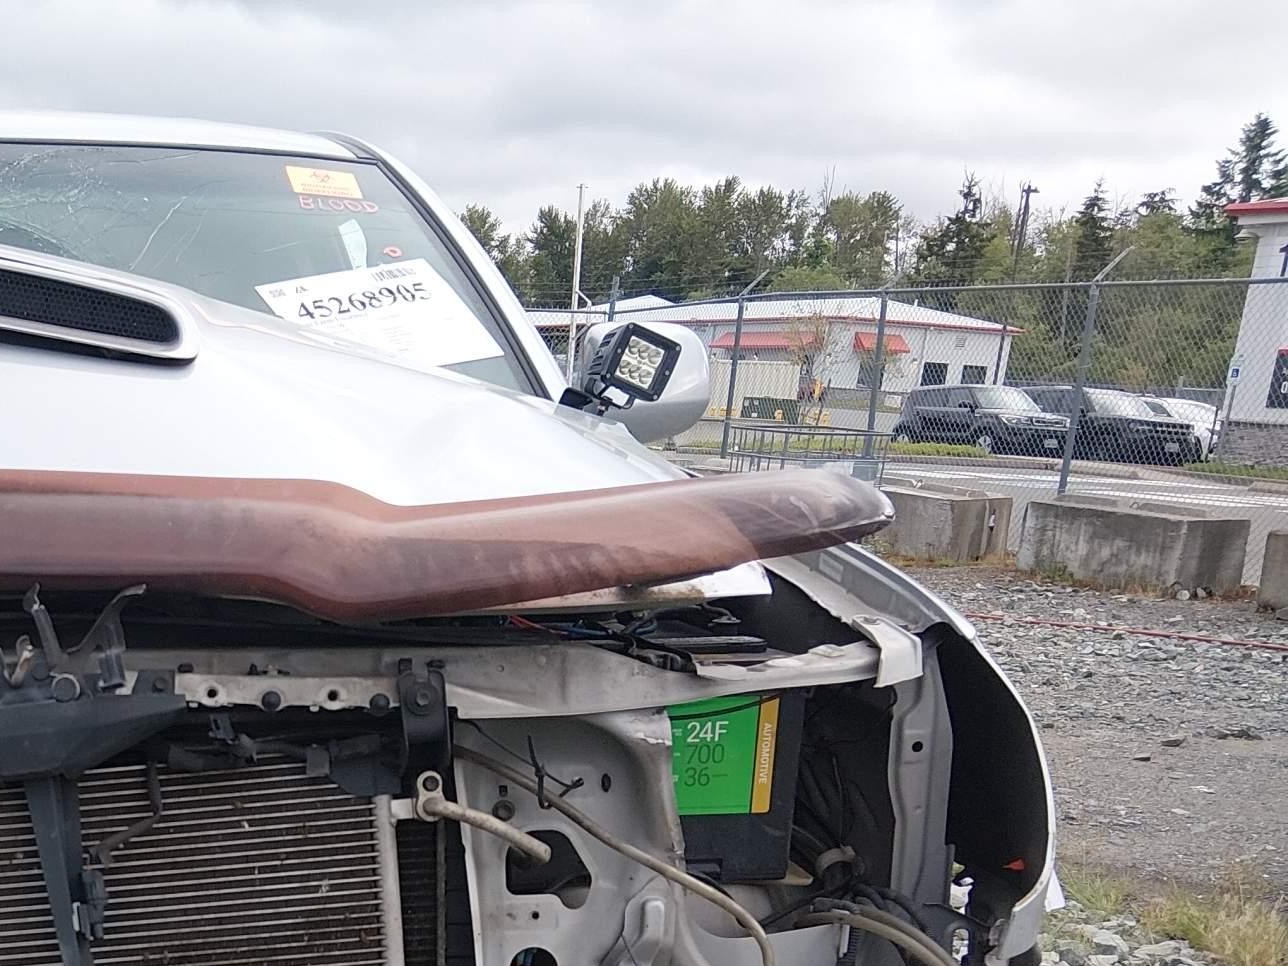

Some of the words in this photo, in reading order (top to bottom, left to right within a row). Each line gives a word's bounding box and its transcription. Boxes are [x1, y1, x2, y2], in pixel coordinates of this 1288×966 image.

[299, 196, 379, 214] BLOOD
[298, 281, 433, 320] 45268905
[686, 720, 729, 743] 24F
[686, 743, 725, 765] 700
[758, 722, 773, 785] AUTOMOTIVE
